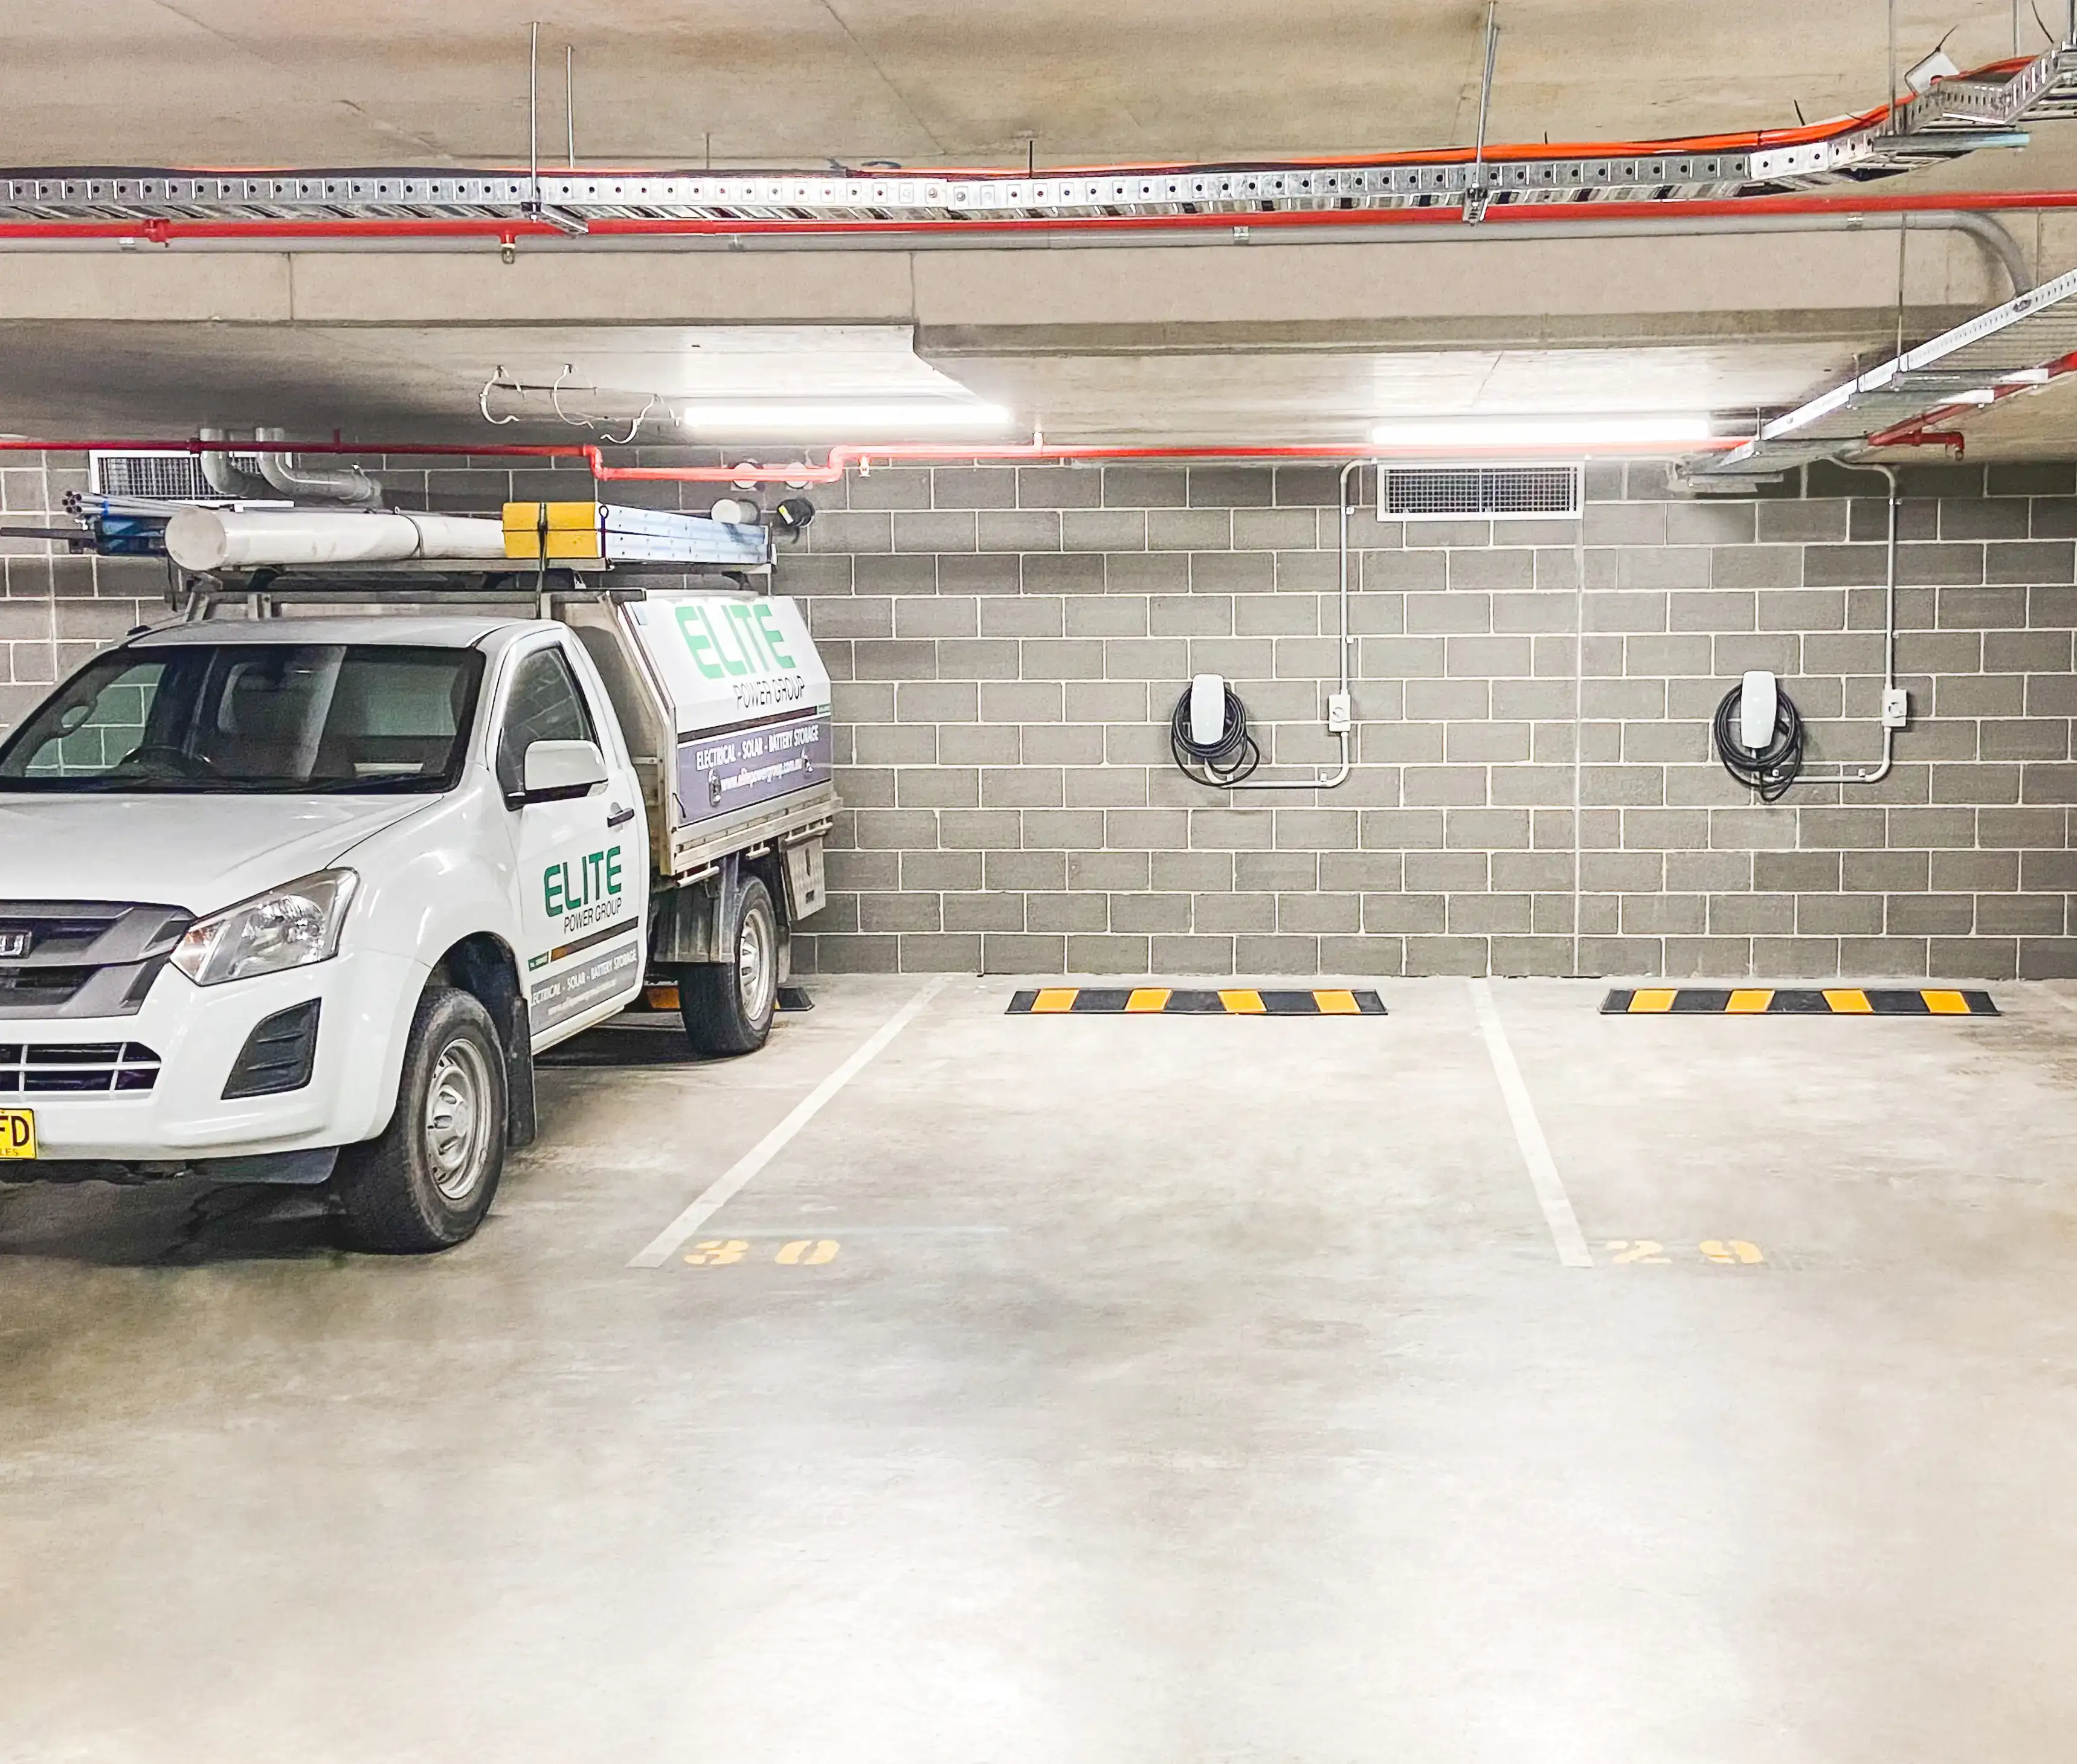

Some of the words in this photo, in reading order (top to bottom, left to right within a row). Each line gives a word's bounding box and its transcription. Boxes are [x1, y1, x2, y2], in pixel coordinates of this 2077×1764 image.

[675, 605, 796, 679] ELITE
[733, 680, 771, 710] POWER
[772, 675, 805, 703] GROUP
[696, 744, 736, 771] ELECTRICAL
[742, 736, 764, 760] SOLAR
[768, 730, 794, 753] BATTERY
[793, 724, 819, 747] STORAGE
[544, 845, 622, 918] ELITE
[564, 907, 593, 935] POWER
[595, 897, 622, 922] GROUP
[567, 971, 586, 991] SOLAR
[590, 959, 613, 980] BATTERY
[684, 1240, 840, 1265] 30
[1606, 1240, 1763, 1264] 29
